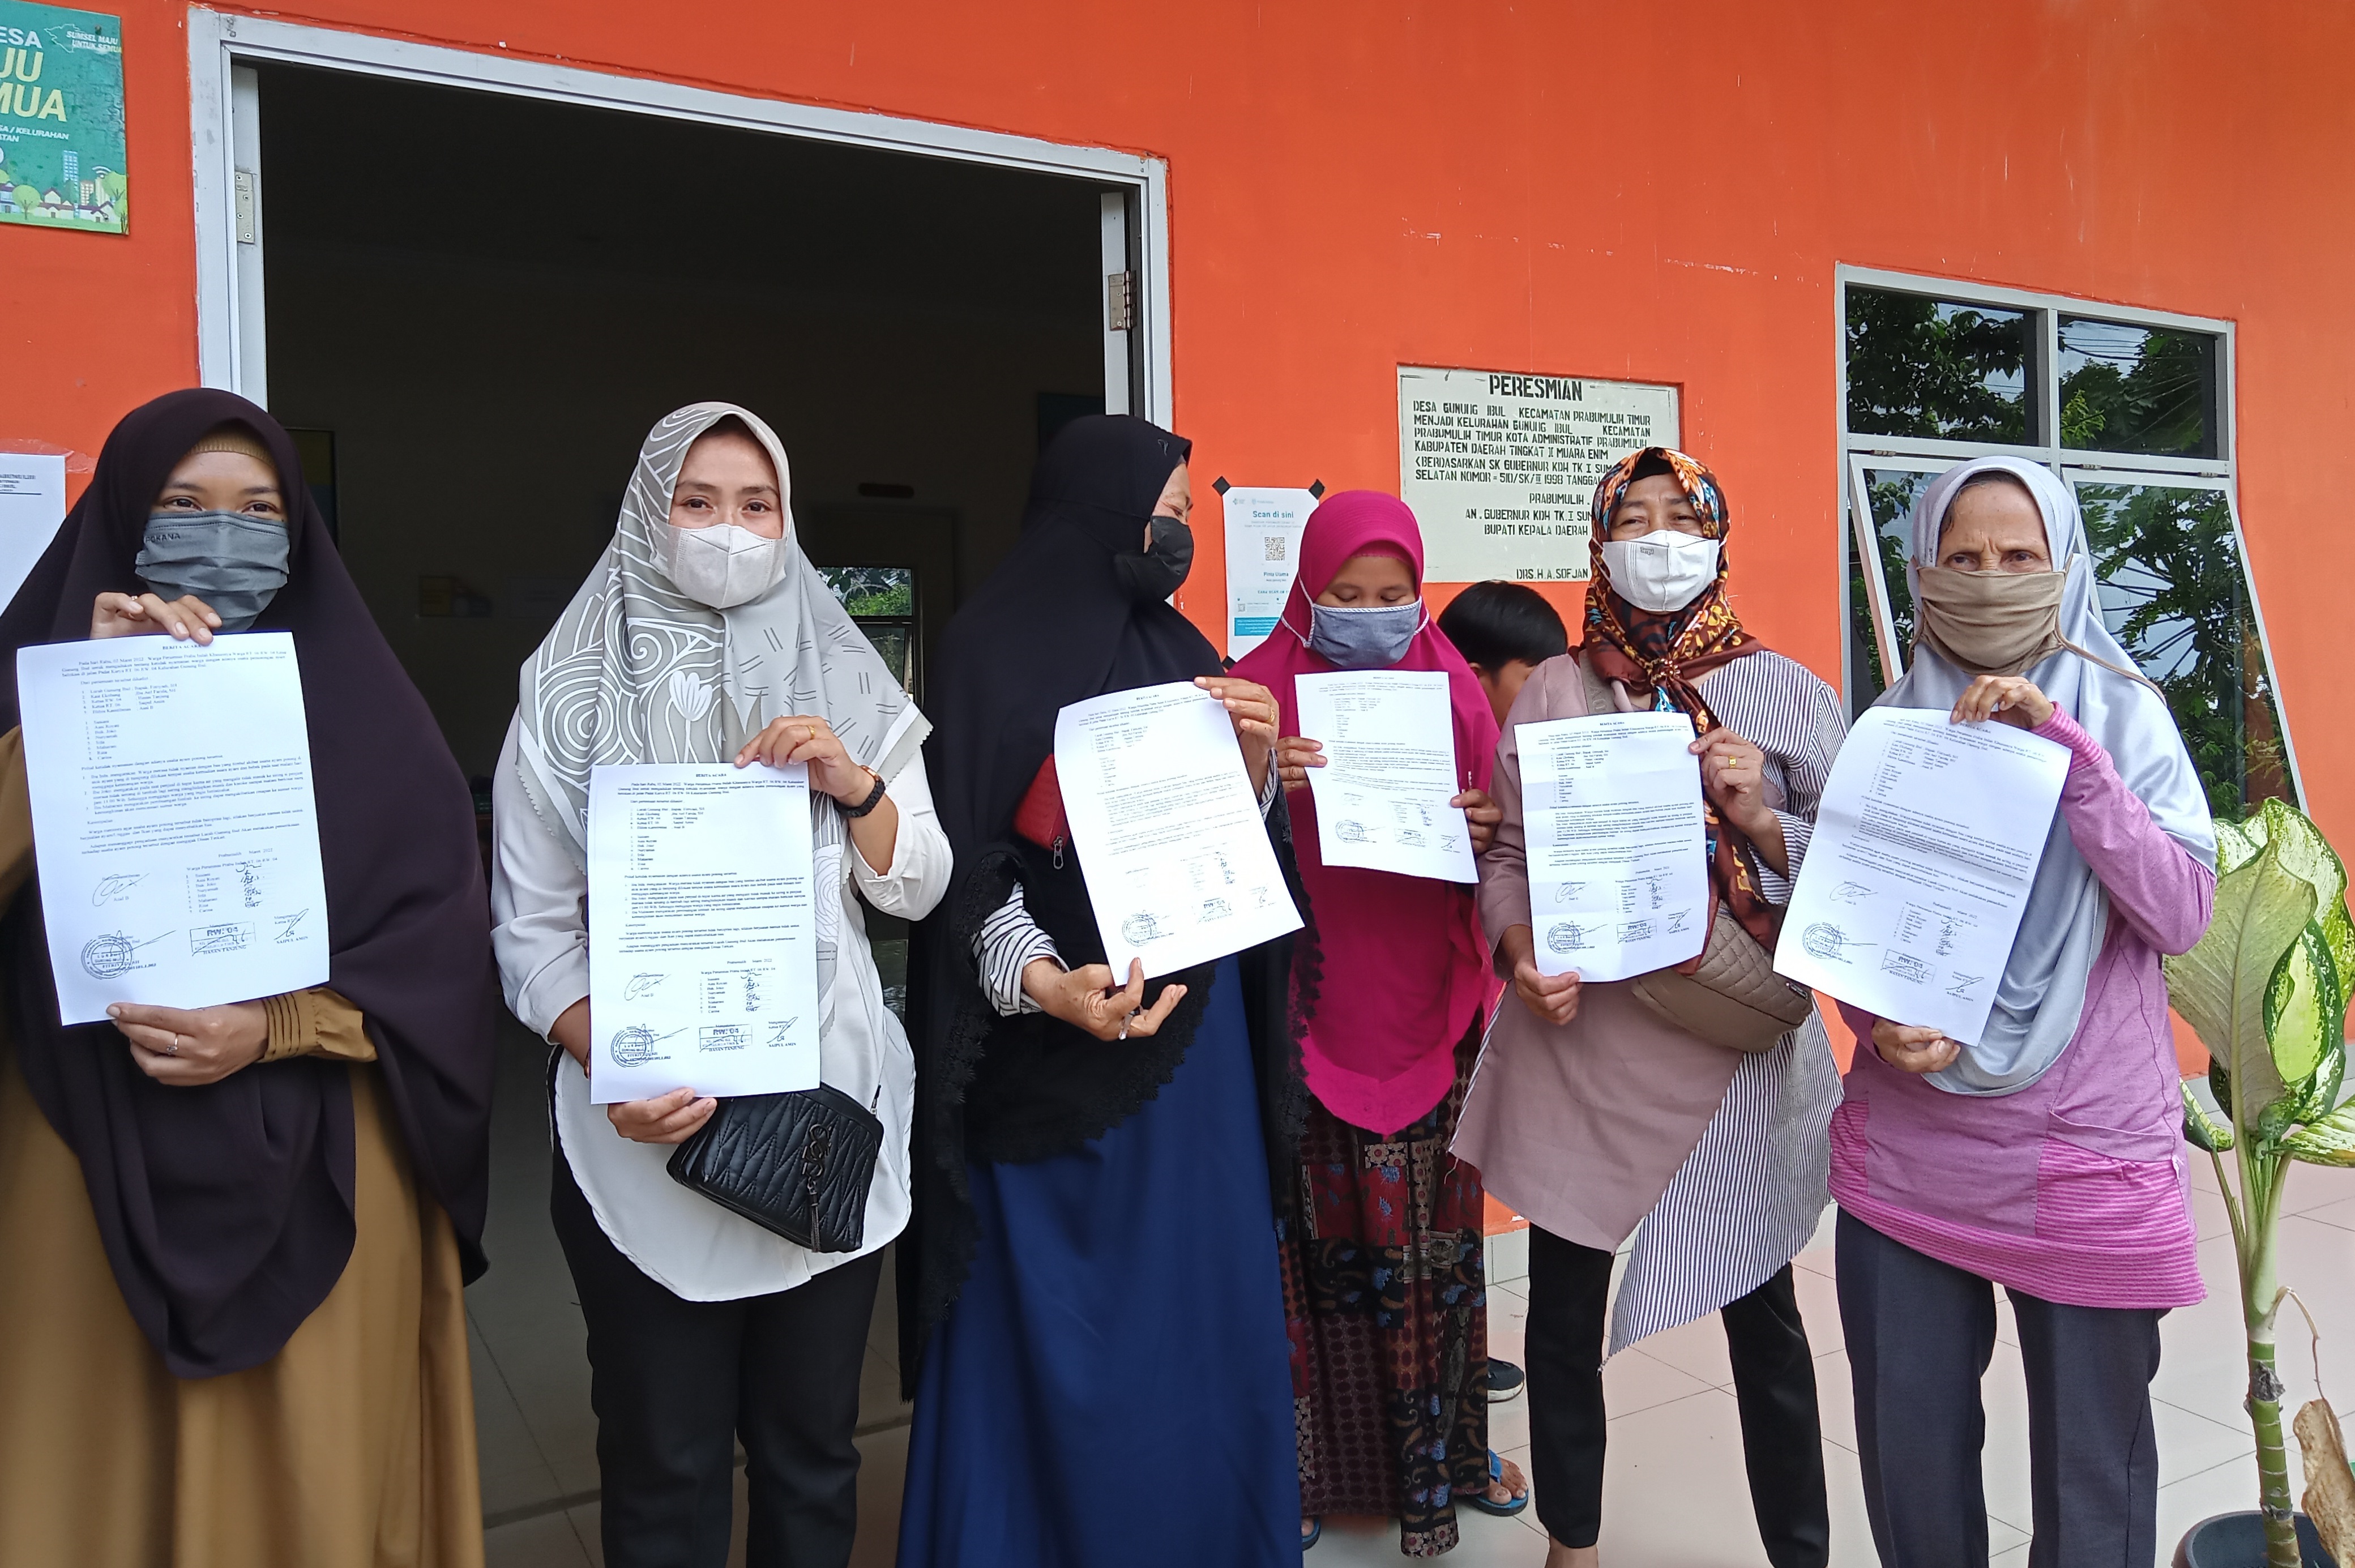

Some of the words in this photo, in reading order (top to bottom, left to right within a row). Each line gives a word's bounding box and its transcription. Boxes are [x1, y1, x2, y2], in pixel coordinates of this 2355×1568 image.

[72, 39, 96, 50] UNTUK
[98, 36, 118, 45] MAJU
[16, 126, 70, 140] KELURAHAN
[1489, 374, 1583, 401] PERESMIAN
[1413, 400, 1437, 413] DESA
[1487, 405, 1506, 417] IBUL
[1519, 407, 1570, 421] KECAMATAN
[1573, 411, 1624, 425] PRABUMULIH
[1627, 414, 1651, 426] TIMUR
[1414, 415, 1454, 427] MENJADI
[1457, 416, 1509, 429] KELURAHAN
[1554, 423, 1573, 434] IBUL
[1602, 425, 1651, 437] KECAMATAN
[1414, 428, 1472, 441] PRABUMULIH
[1476, 430, 1502, 442] TIMUR
[1506, 432, 1528, 443] KOTA
[1532, 433, 1593, 446] ADMINISTRATIF
[1597, 437, 1647, 449] PRABUMULIH
[1414, 440, 1468, 454] KABUPATEN
[1471, 443, 1506, 455] DAERAH
[1509, 445, 1545, 458] TINGKAT
[1557, 447, 1585, 459] MUARA
[1588, 448, 1609, 460] ENIM
[1489, 459, 1501, 470] SK
[1504, 460, 1549, 472] GUBERNUR
[1552, 462, 1569, 473] KDH
[1572, 462, 1583, 473] TK
[1416, 469, 1457, 481] SELATAN
[1460, 471, 1491, 482] NOMOR
[1544, 474, 1563, 485] 1998
[1529, 493, 1584, 505] PRABUMULIH
[1533, 510, 1550, 521] KDH
[1484, 524, 1515, 535] BUPATI
[1519, 525, 1552, 536] KEPALA
[1555, 525, 1588, 536] DAERAH
